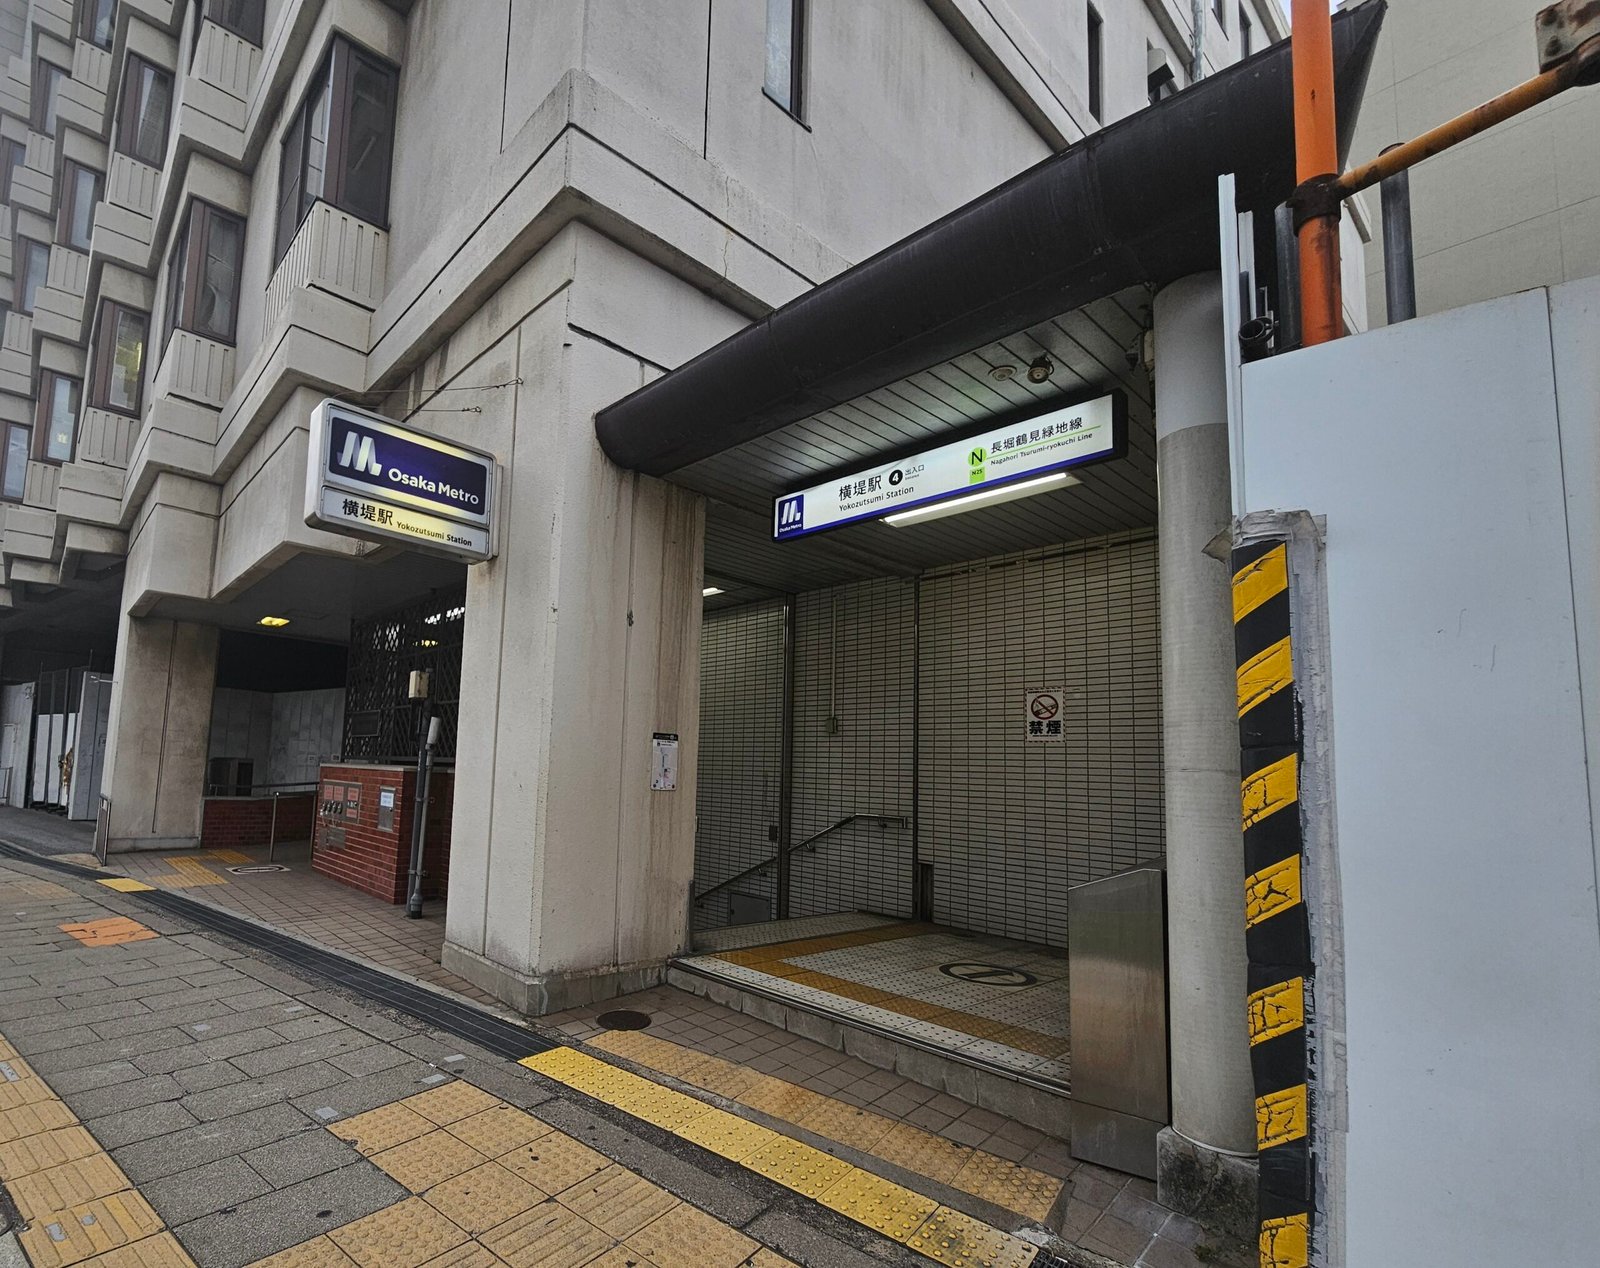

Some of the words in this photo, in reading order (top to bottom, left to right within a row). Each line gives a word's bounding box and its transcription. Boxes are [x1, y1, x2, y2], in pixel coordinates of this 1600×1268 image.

[990, 417, 1083, 454] 長堀鶴見緑地線
[972, 449, 983, 465] N
[990, 453, 1019, 466] Nagahori
[1020, 437, 1076, 457] Tsurumi-ryokuchi
[1077, 433, 1093, 442] Line
[388, 468, 436, 492] Osaka
[438, 482, 479, 505] Metro
[838, 475, 882, 501] 横堤駅
[839, 494, 884, 512] Yokozutsumi
[886, 486, 914, 500] Station
[342, 498, 393, 526] 横堤駅
[396, 521, 445, 540] Yokozutsumi
[446, 534, 472, 547] Station
[1029, 720, 1062, 735] 禁煙
